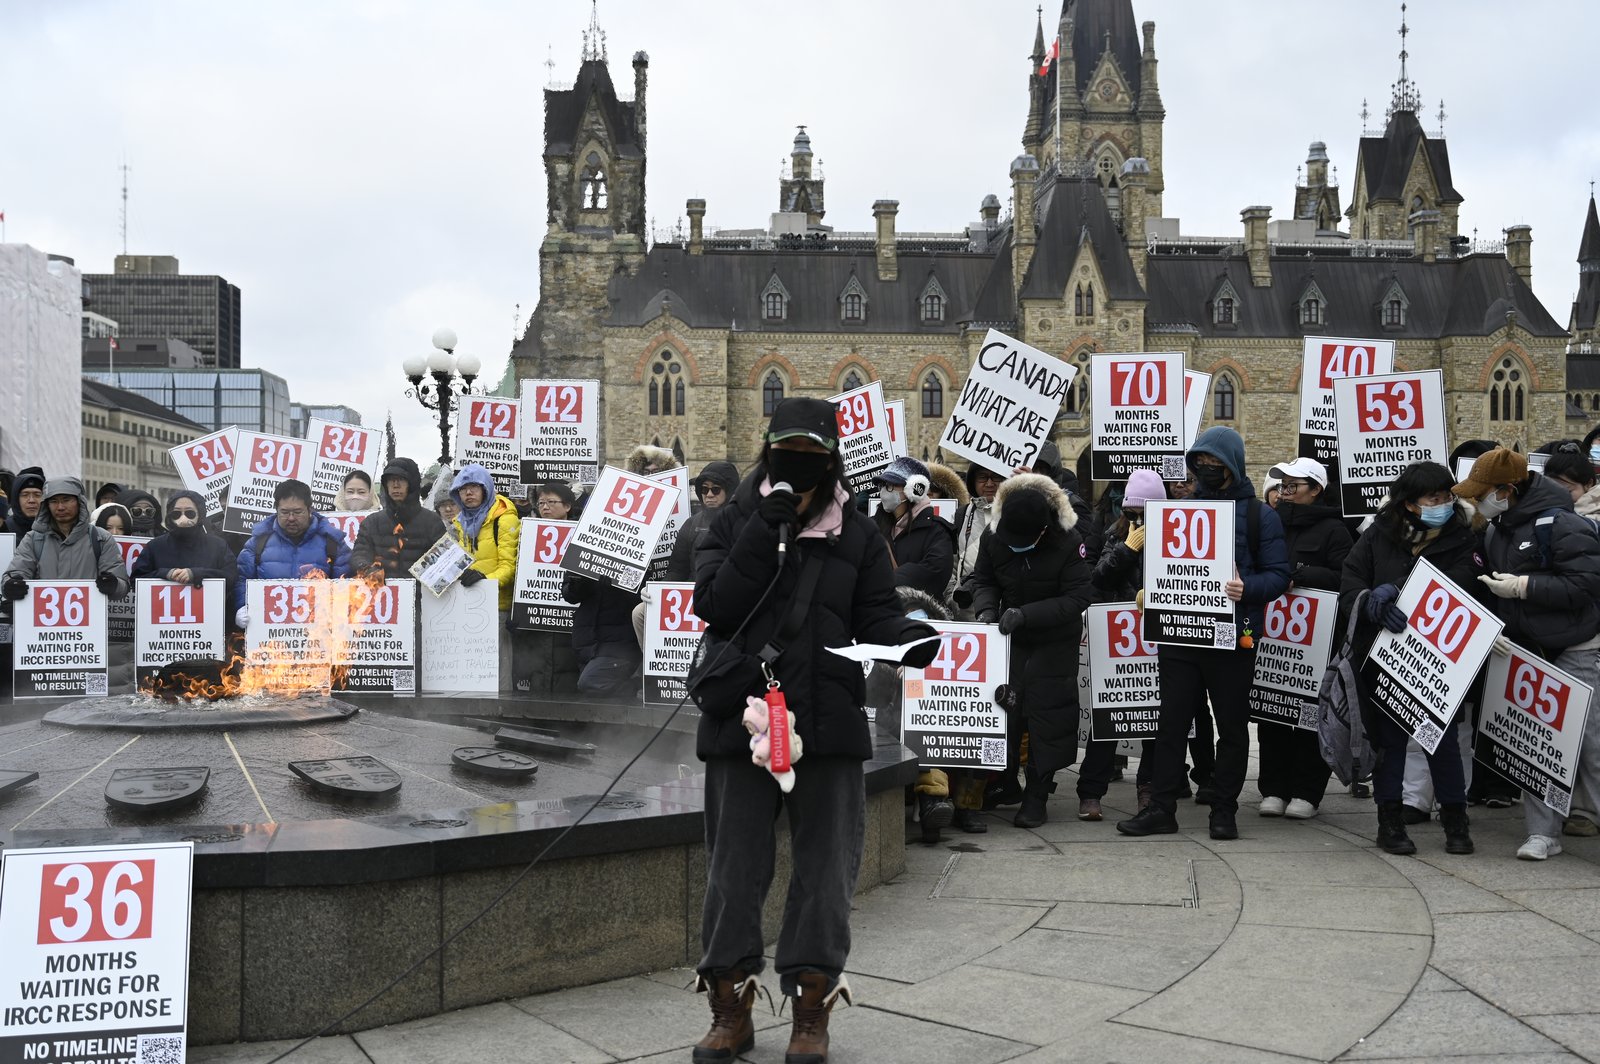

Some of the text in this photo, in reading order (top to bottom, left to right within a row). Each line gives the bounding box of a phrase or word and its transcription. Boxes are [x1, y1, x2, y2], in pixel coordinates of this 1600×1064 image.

[1326, 346, 1368, 378] 40
[979, 342, 1069, 405] CANADA
[1117, 362, 1160, 405] 70
[541, 387, 577, 421] 42
[961, 379, 1048, 439] WHAT ARE
[1366, 382, 1416, 431] 53
[475, 403, 511, 437] 42
[839, 395, 869, 435] 39
[1116, 410, 1159, 420] MONTHS
[540, 427, 577, 435] MONTHS
[946, 415, 976, 448] YOU
[1104, 423, 1171, 433] WAITING FOR
[1306, 420, 1327, 430] IRCC
[325, 428, 361, 463] 34
[475, 441, 510, 450] MONTHS
[531, 438, 587, 446] WAITING FOR
[844, 434, 873, 449] MONTHS
[1099, 436, 1178, 445] IRCC RESPONSE
[1315, 439, 1325, 448] NO
[1366, 436, 1417, 448] MONTHS
[465, 450, 500, 459] WAITING
[526, 448, 592, 456] IRCC RESPONSE
[869, 442, 883, 454] FOR
[1318, 450, 1328, 458] NO
[193, 438, 232, 476] 34
[255, 441, 295, 476] 30
[852, 451, 889, 470] RESPONSE
[1109, 455, 1120, 463] NO
[1354, 449, 1431, 463] WAITING FOR
[1113, 465, 1124, 473] NO
[1348, 467, 1374, 478] IRCC
[1361, 487, 1374, 496] NO
[234, 496, 254, 505] IRCC
[613, 481, 650, 522] 51
[1367, 499, 1379, 507] NO
[601, 517, 640, 535] MONTHS
[588, 524, 645, 549] WAITING FOR
[1167, 510, 1210, 558] 30
[577, 533, 646, 561] IRCC RESPONSE
[580, 551, 590, 560] NO
[578, 561, 589, 570] NO
[1167, 564, 1209, 576] MONTHS
[1157, 579, 1220, 592] WAITING FOR
[520, 590, 539, 599] IRCC
[1150, 593, 1227, 607] IRCC RESPONSE
[39, 588, 84, 626] 36
[159, 586, 196, 623] 11
[269, 586, 311, 622] 35
[354, 587, 393, 623] 20
[542, 618, 574, 627] RESULTS
[1160, 614, 1216, 626] NO TIMELINES
[1265, 594, 1310, 642] 68
[1417, 588, 1471, 654] 90
[39, 632, 82, 640] MONTHS
[160, 630, 201, 638] MONTHS
[269, 628, 309, 638] MONTHS
[353, 629, 392, 638] MONTHS
[1163, 626, 1212, 638] NO RESULTS
[27, 644, 94, 652] WAITING FOR
[149, 642, 212, 650] WAITING FOR
[259, 640, 320, 649] WAITING FOR
[343, 641, 402, 650] WAITING FOR
[143, 653, 164, 662] IRCC
[358, 652, 408, 661] RESPONSE
[655, 650, 690, 659] WAITING
[931, 634, 980, 680] 42
[1260, 643, 1304, 660] MONTHS
[1405, 634, 1446, 674] MONTHS
[21, 655, 100, 665] IRCC RESPONSE
[649, 662, 668, 671] IRCC
[1293, 663, 1313, 676] FOR
[1390, 639, 1450, 696] WAITING FOR
[50, 682, 86, 690] RESULTS
[658, 680, 667, 688] NO
[1104, 677, 1151, 688] WAITING
[1262, 672, 1318, 691] RESPONSE
[1377, 673, 1390, 687] NO
[1377, 647, 1449, 714] IRCC RESPONSE
[661, 690, 671, 698] NO
[931, 686, 979, 697] MONTHS
[1098, 692, 1123, 702] IRCC
[1513, 663, 1562, 723] 65
[919, 700, 992, 712] WAITING FOR
[1262, 702, 1299, 718] RESULTS
[1375, 686, 1421, 730] NO RESULTS
[912, 714, 999, 727] IRCC RESPONSE
[1111, 712, 1123, 720] NO
[1115, 724, 1128, 732] NO
[1507, 707, 1552, 741] MONTHS
[774, 705, 783, 766] lululemon
[923, 736, 935, 745] NO
[1494, 712, 1562, 762] WAITING FOR
[927, 748, 982, 758] NO RESULTS
[1485, 721, 1567, 778] IRCC RESPONSE
[1493, 745, 1506, 758] NO
[1495, 757, 1546, 795] NO RESULTS
[50, 861, 143, 941] 36
[46, 951, 137, 973] MONTHS
[20, 974, 160, 1000] WAITING FOR
[4, 998, 172, 1026] IRCC RESPONSE
[24, 1042, 49, 1059] NO
